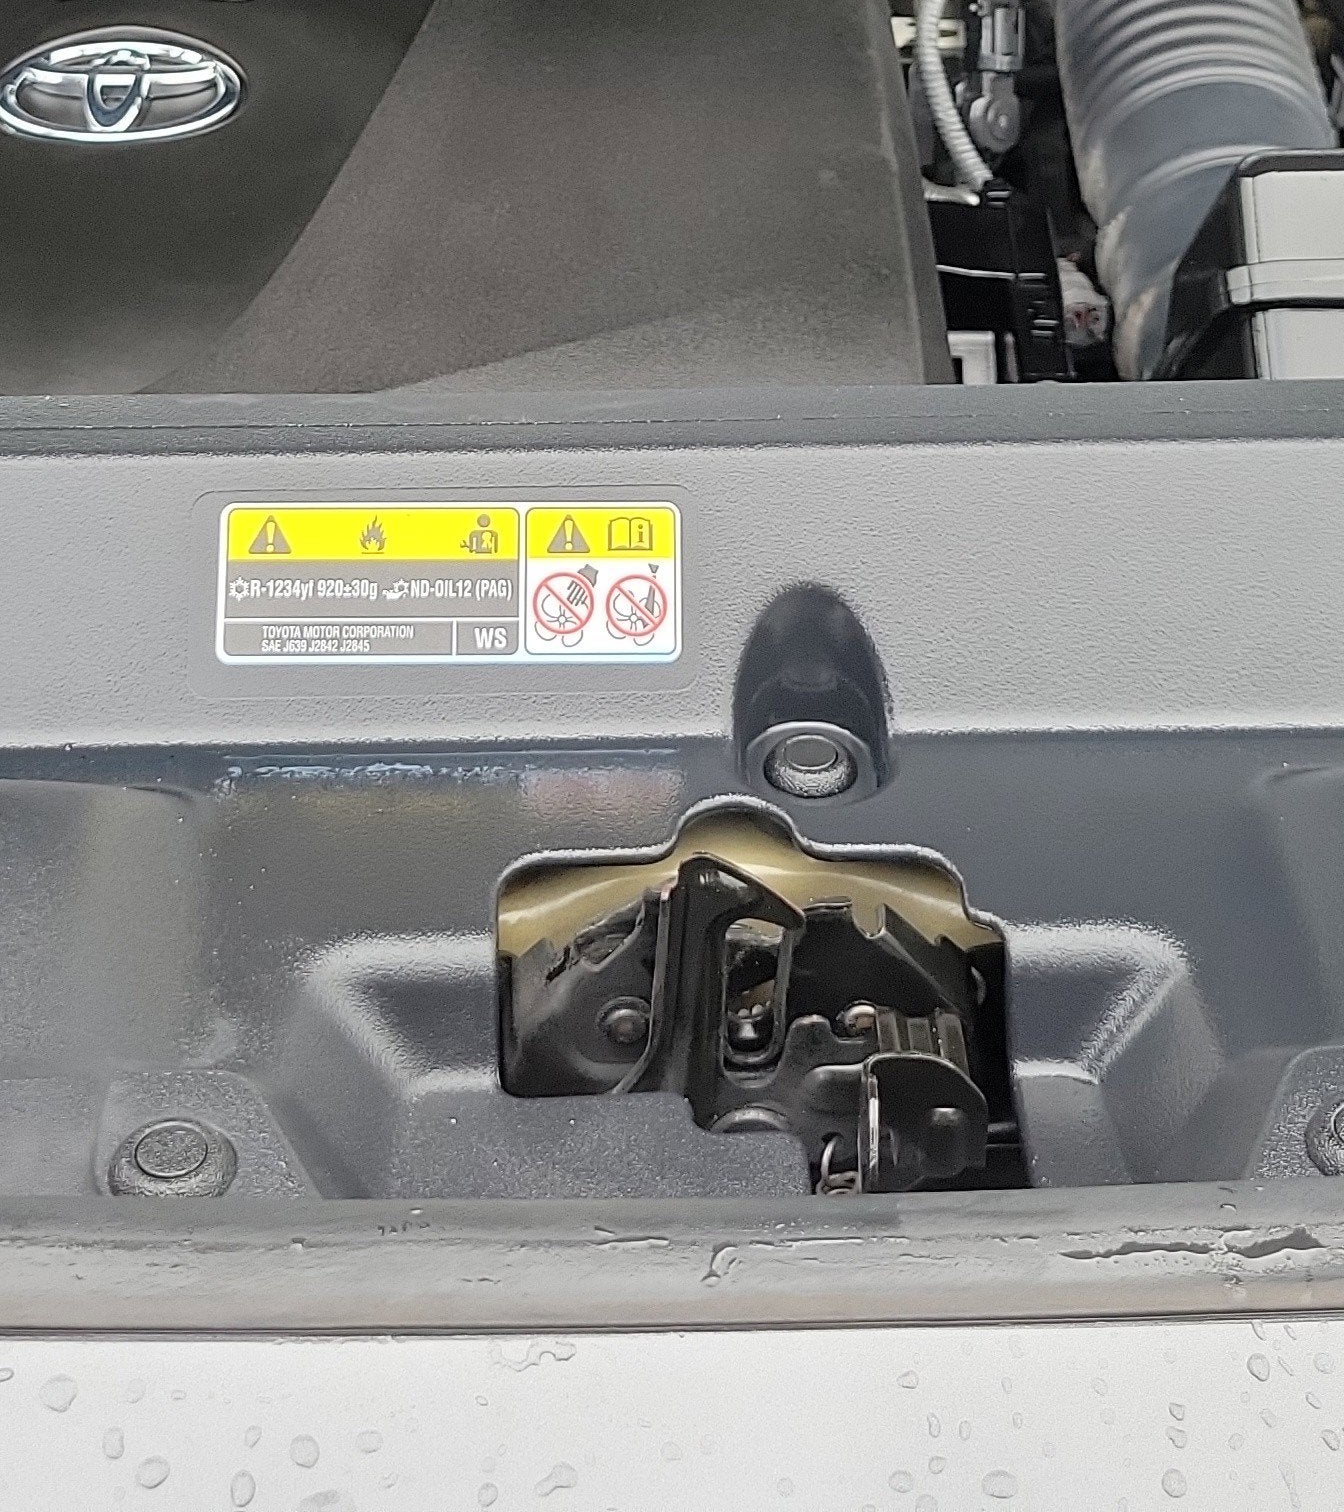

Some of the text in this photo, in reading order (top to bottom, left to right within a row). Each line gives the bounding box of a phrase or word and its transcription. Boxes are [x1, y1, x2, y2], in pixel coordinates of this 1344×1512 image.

[250, 578, 513, 601] R-1234yf 920±30g ND-OIL12 (PAG)
[262, 624, 415, 639] TOYOTA MOTOR CORPORATION
[474, 626, 508, 651] WS
[261, 639, 372, 653] SAE J639 J2842 J2845
